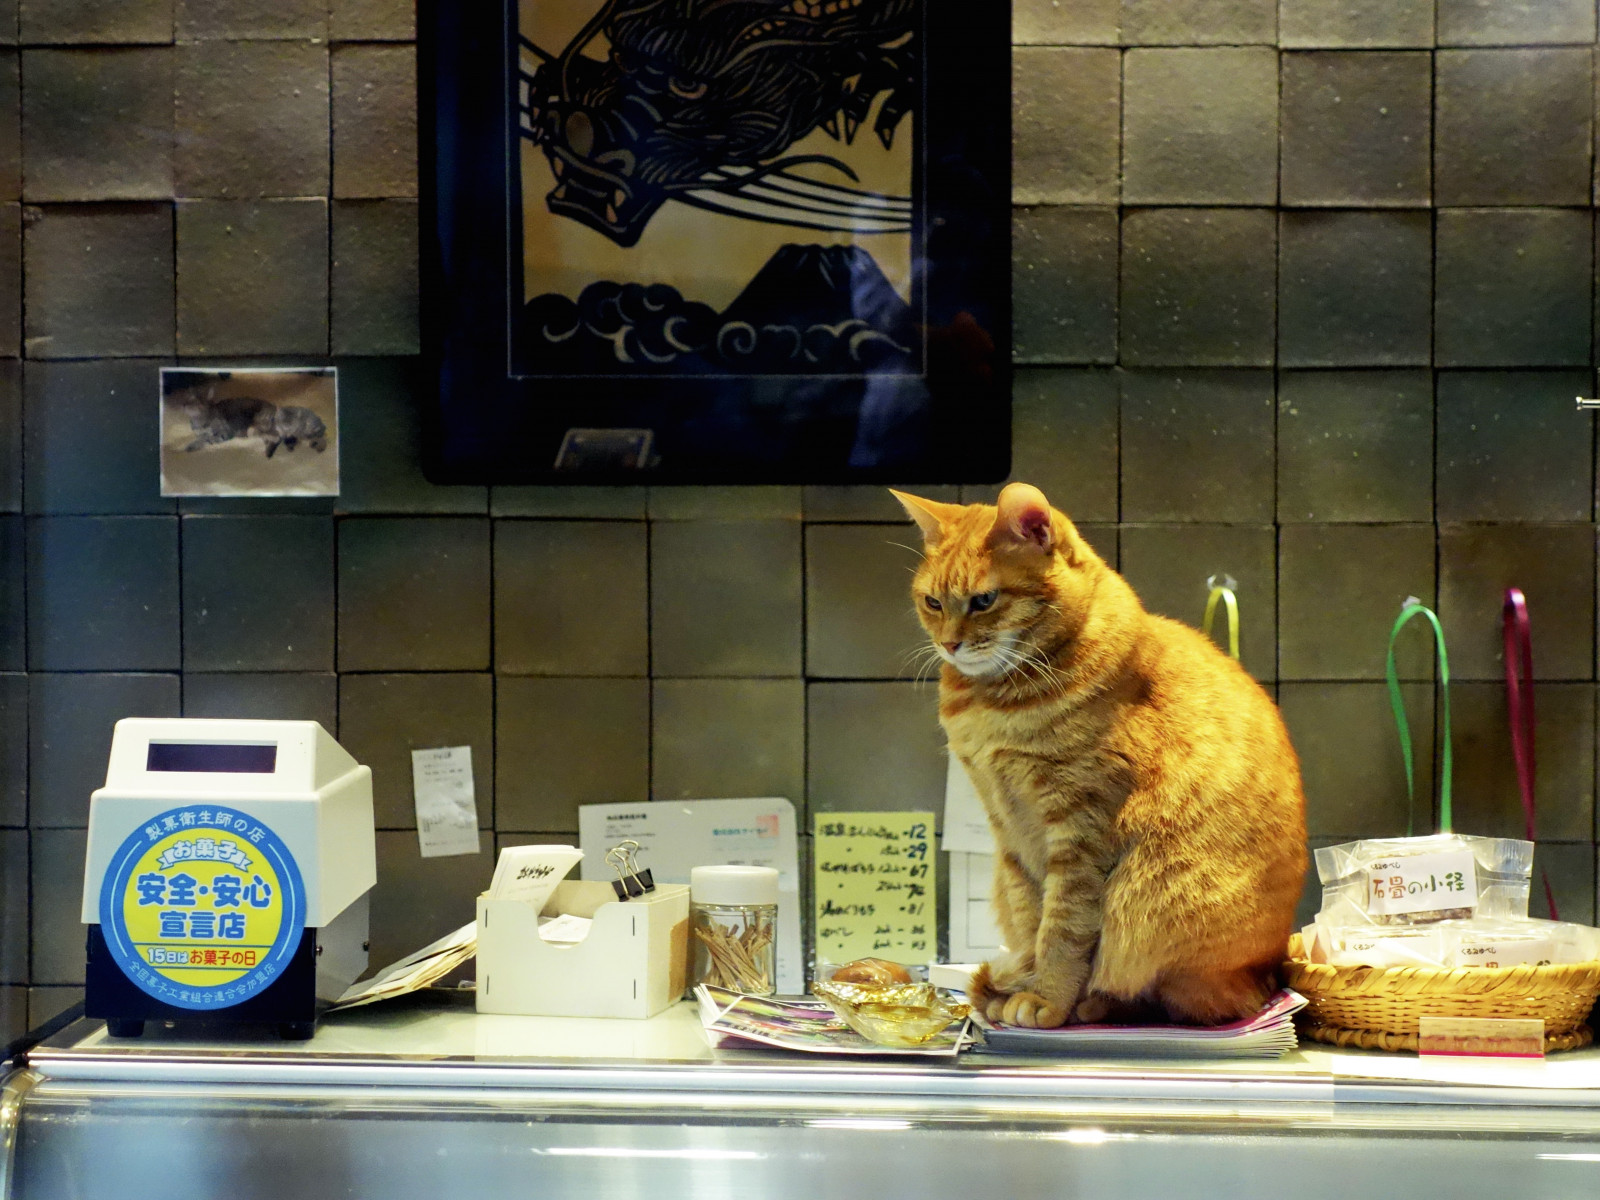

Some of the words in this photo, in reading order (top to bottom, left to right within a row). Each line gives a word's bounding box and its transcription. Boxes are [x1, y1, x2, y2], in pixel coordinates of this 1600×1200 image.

[145, 810, 266, 843] 製菓衛生師の店
[172, 838, 238, 859] お菓子
[136, 872, 272, 909] 安全・安心
[1373, 872, 1465, 899] 石畳の小径
[159, 911, 246, 939] 宣言店
[1461, 947, 1497, 955] くるみゆべし
[128, 960, 276, 1004] 全国菓子工業組合連合会加盟店
